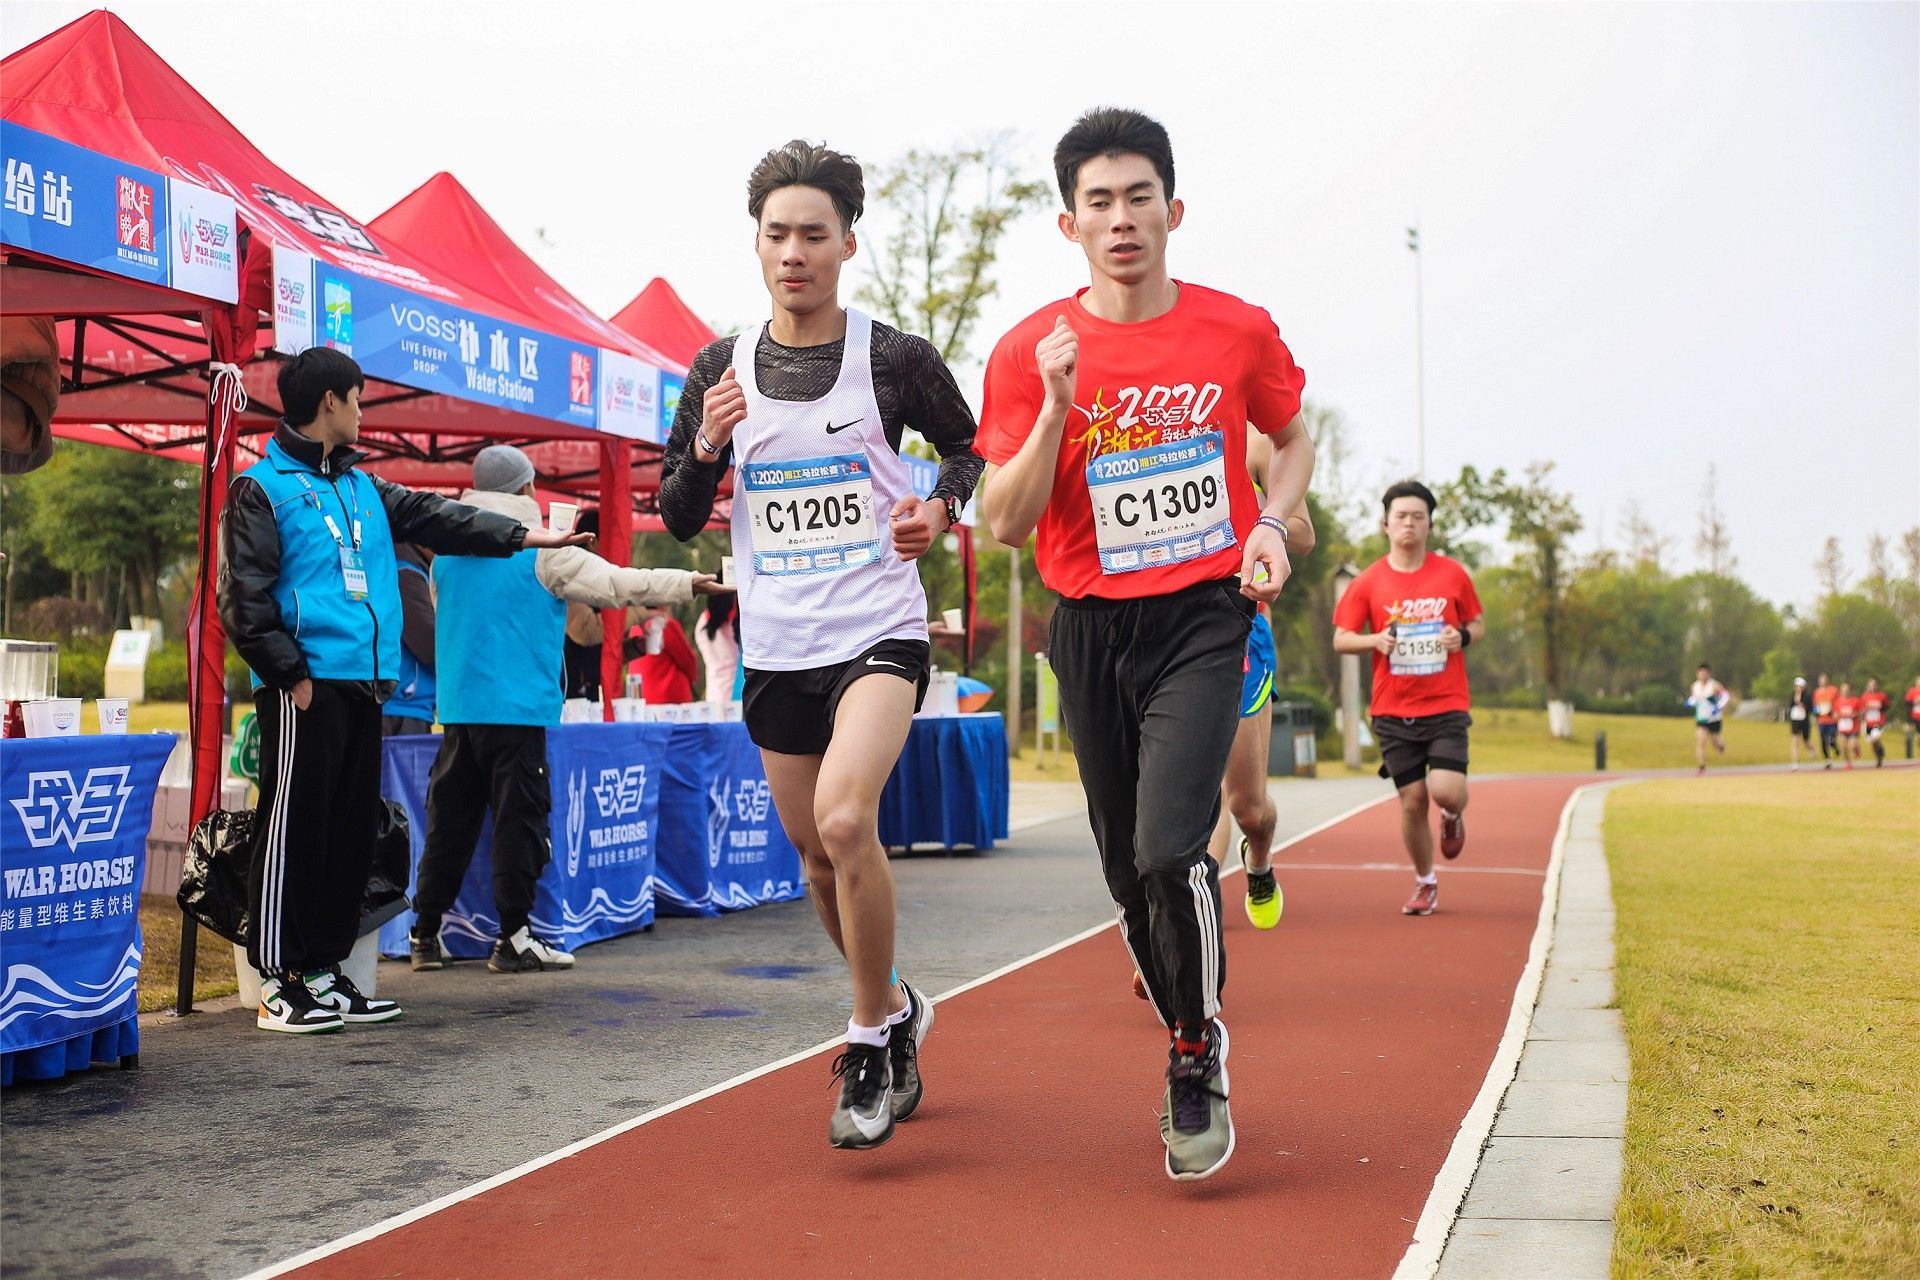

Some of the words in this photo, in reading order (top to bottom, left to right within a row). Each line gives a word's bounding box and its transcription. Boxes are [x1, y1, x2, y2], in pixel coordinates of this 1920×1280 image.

[4, 158, 72, 226] 给站
[195, 245, 209, 257] WAR
[390, 303, 457, 342] VOSS
[401, 339, 420, 354] LIVE
[422, 343, 448, 362] EVERY
[465, 365, 497, 394] Water
[498, 374, 535, 404] Station
[1116, 382, 1223, 429] 2020
[766, 493, 861, 533] C1205
[1115, 475, 1218, 527] C1309
[1401, 597, 1448, 619] 2020
[589, 825, 614, 848] WAR
[612, 820, 648, 844] HORSE
[5, 866, 56, 898] WAR
[59, 856, 135, 893] HORSE
[0, 893, 134, 932] 能量型维生素饮料
